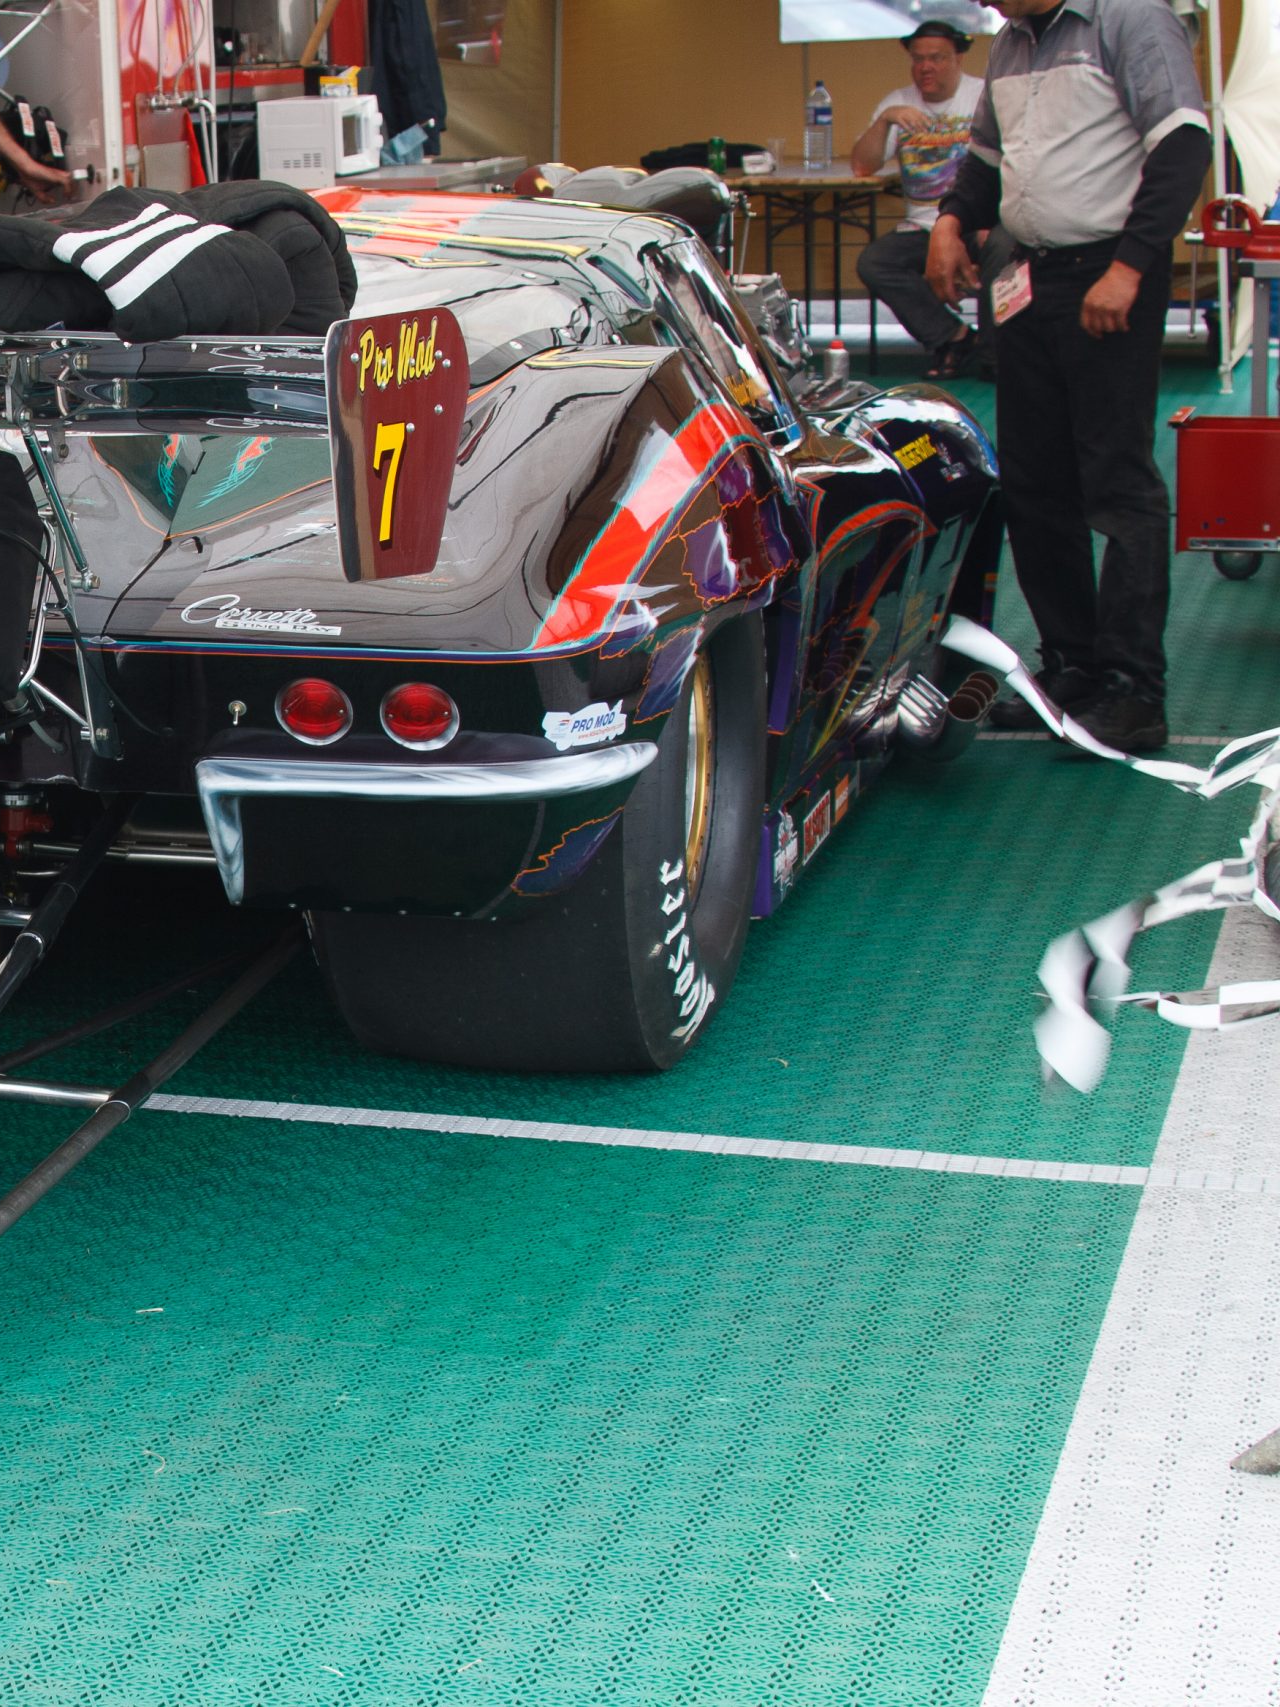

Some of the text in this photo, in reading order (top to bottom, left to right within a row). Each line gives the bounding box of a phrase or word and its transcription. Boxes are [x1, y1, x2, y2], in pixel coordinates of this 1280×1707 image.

[359, 317, 438, 392] Pro Mod
[373, 422, 406, 547] 7
[180, 594, 320, 626] Corvette
[570, 717, 594, 733] PRO
[594, 711, 616, 728] MOD
